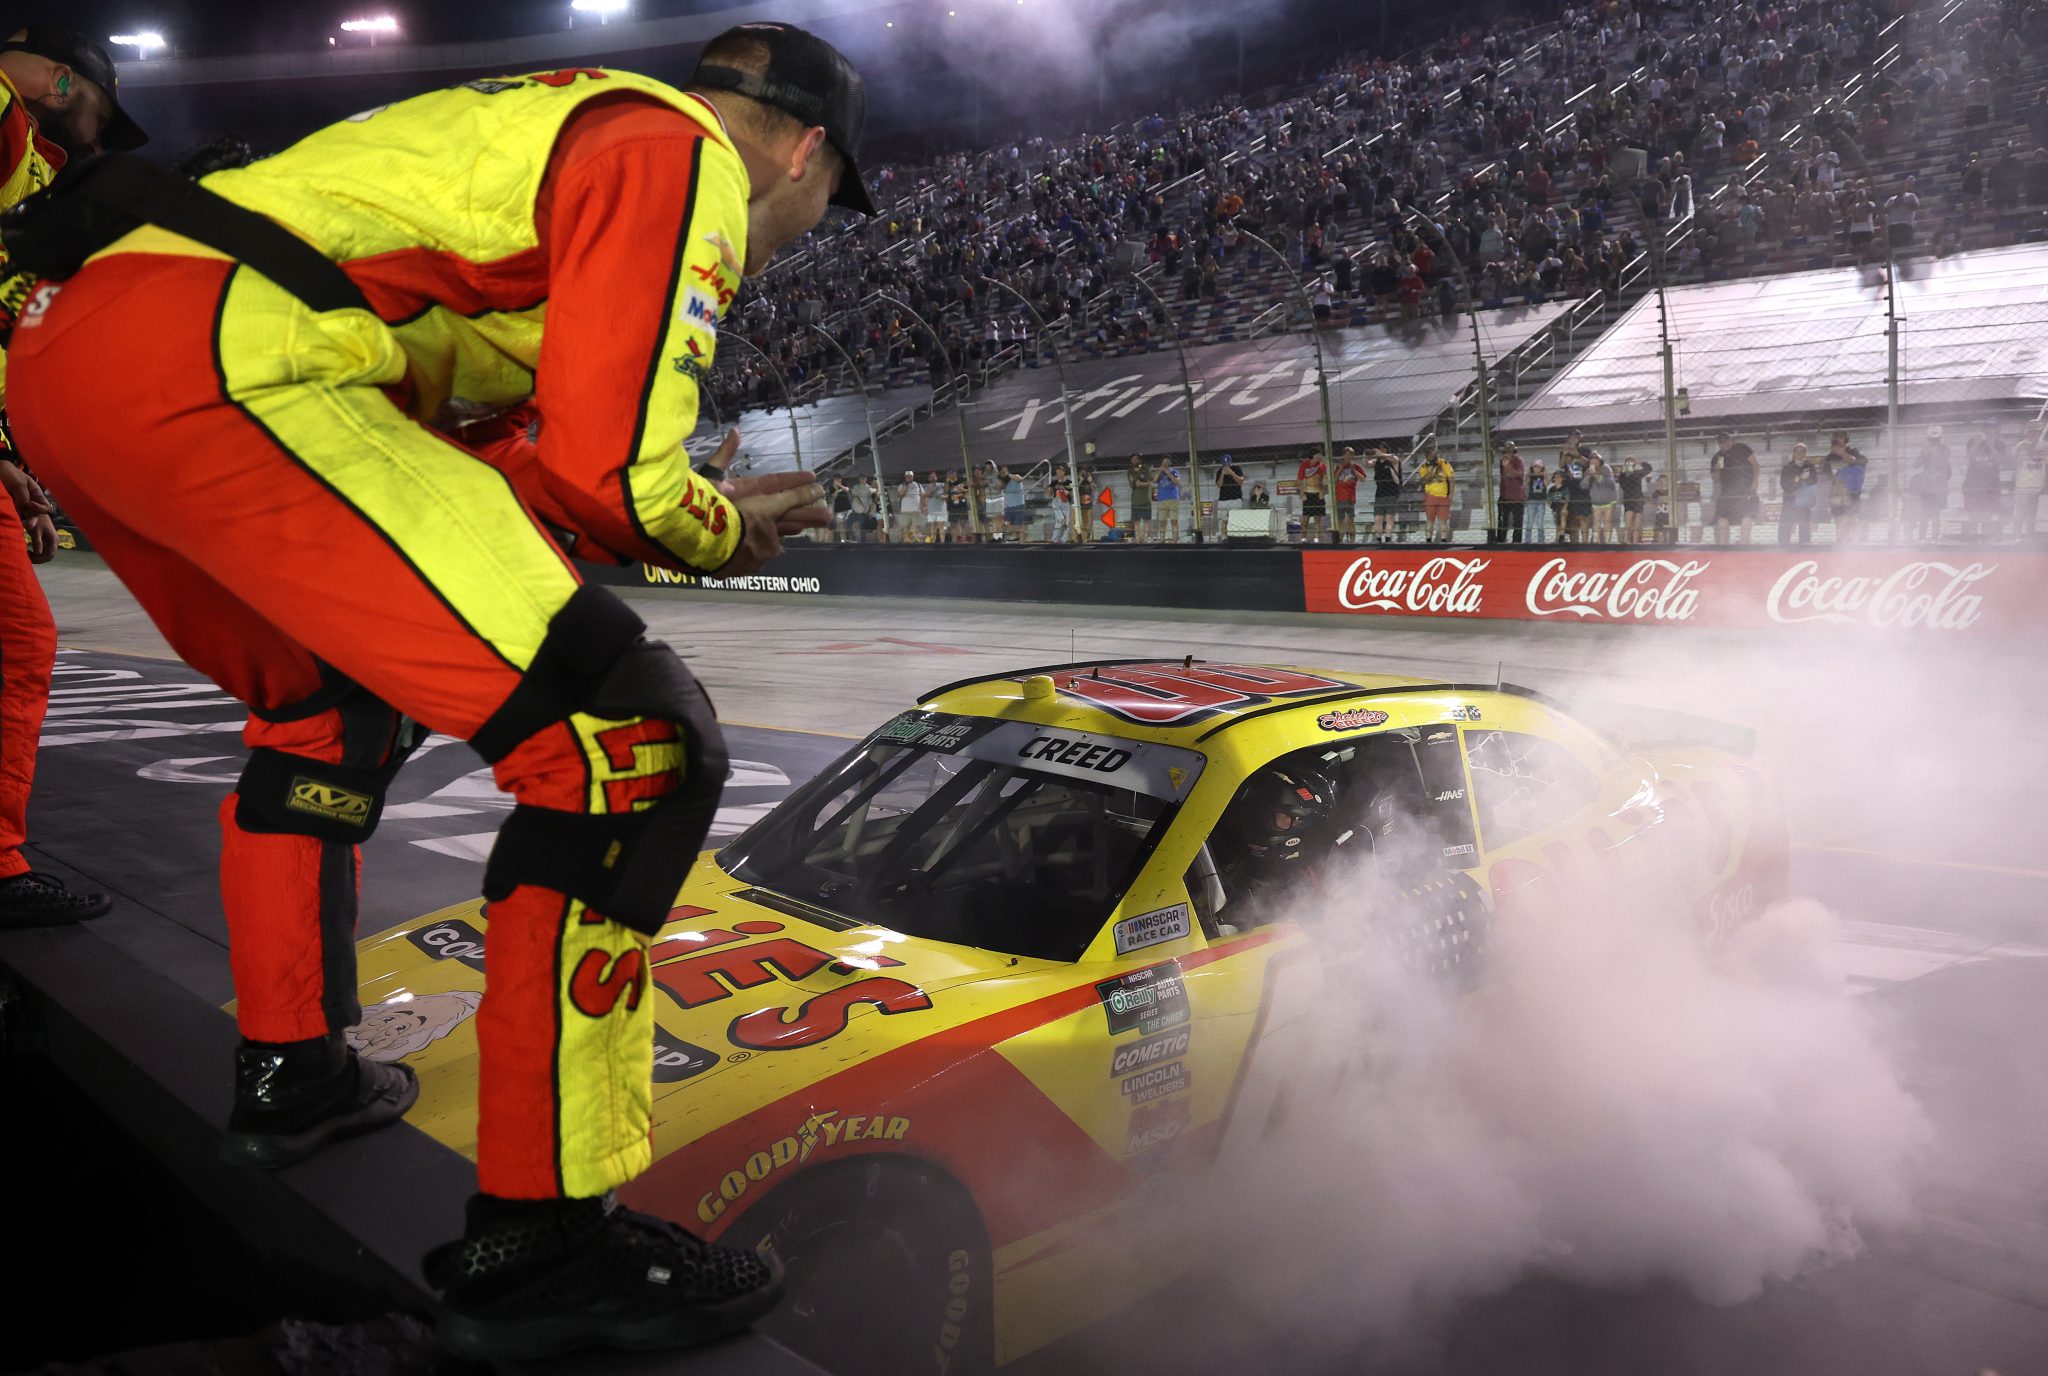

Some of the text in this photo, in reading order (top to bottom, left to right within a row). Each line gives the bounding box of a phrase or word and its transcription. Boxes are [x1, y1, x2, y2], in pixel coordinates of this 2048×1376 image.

[791, 577, 820, 592] OHIO
[1338, 556, 1491, 613] Coca-Cola
[1525, 558, 1711, 620] Coca-Cola
[1766, 560, 1999, 629] Coca-Cola
[918, 733, 960, 748] PARTS
[937, 723, 972, 735] AUTO
[1018, 736, 1132, 773] CREED
[1138, 909, 1180, 931] NASCAR
[1127, 923, 1181, 947] RACE CAR
[1128, 969, 1154, 984] NASCAR
[1157, 976, 1176, 990] AUTO
[1111, 984, 1157, 1014] O'Reilly
[1157, 986, 1180, 1000] PARTS
[1140, 1008, 1158, 1020] SERIES
[1146, 1018, 1161, 1031] THE
[1114, 1032, 1188, 1071] COMETIC
[1124, 1063, 1180, 1093] LINCOLN
[1137, 1078, 1185, 1102] WELDERS
[697, 1110, 911, 1223] GOODYEAR
